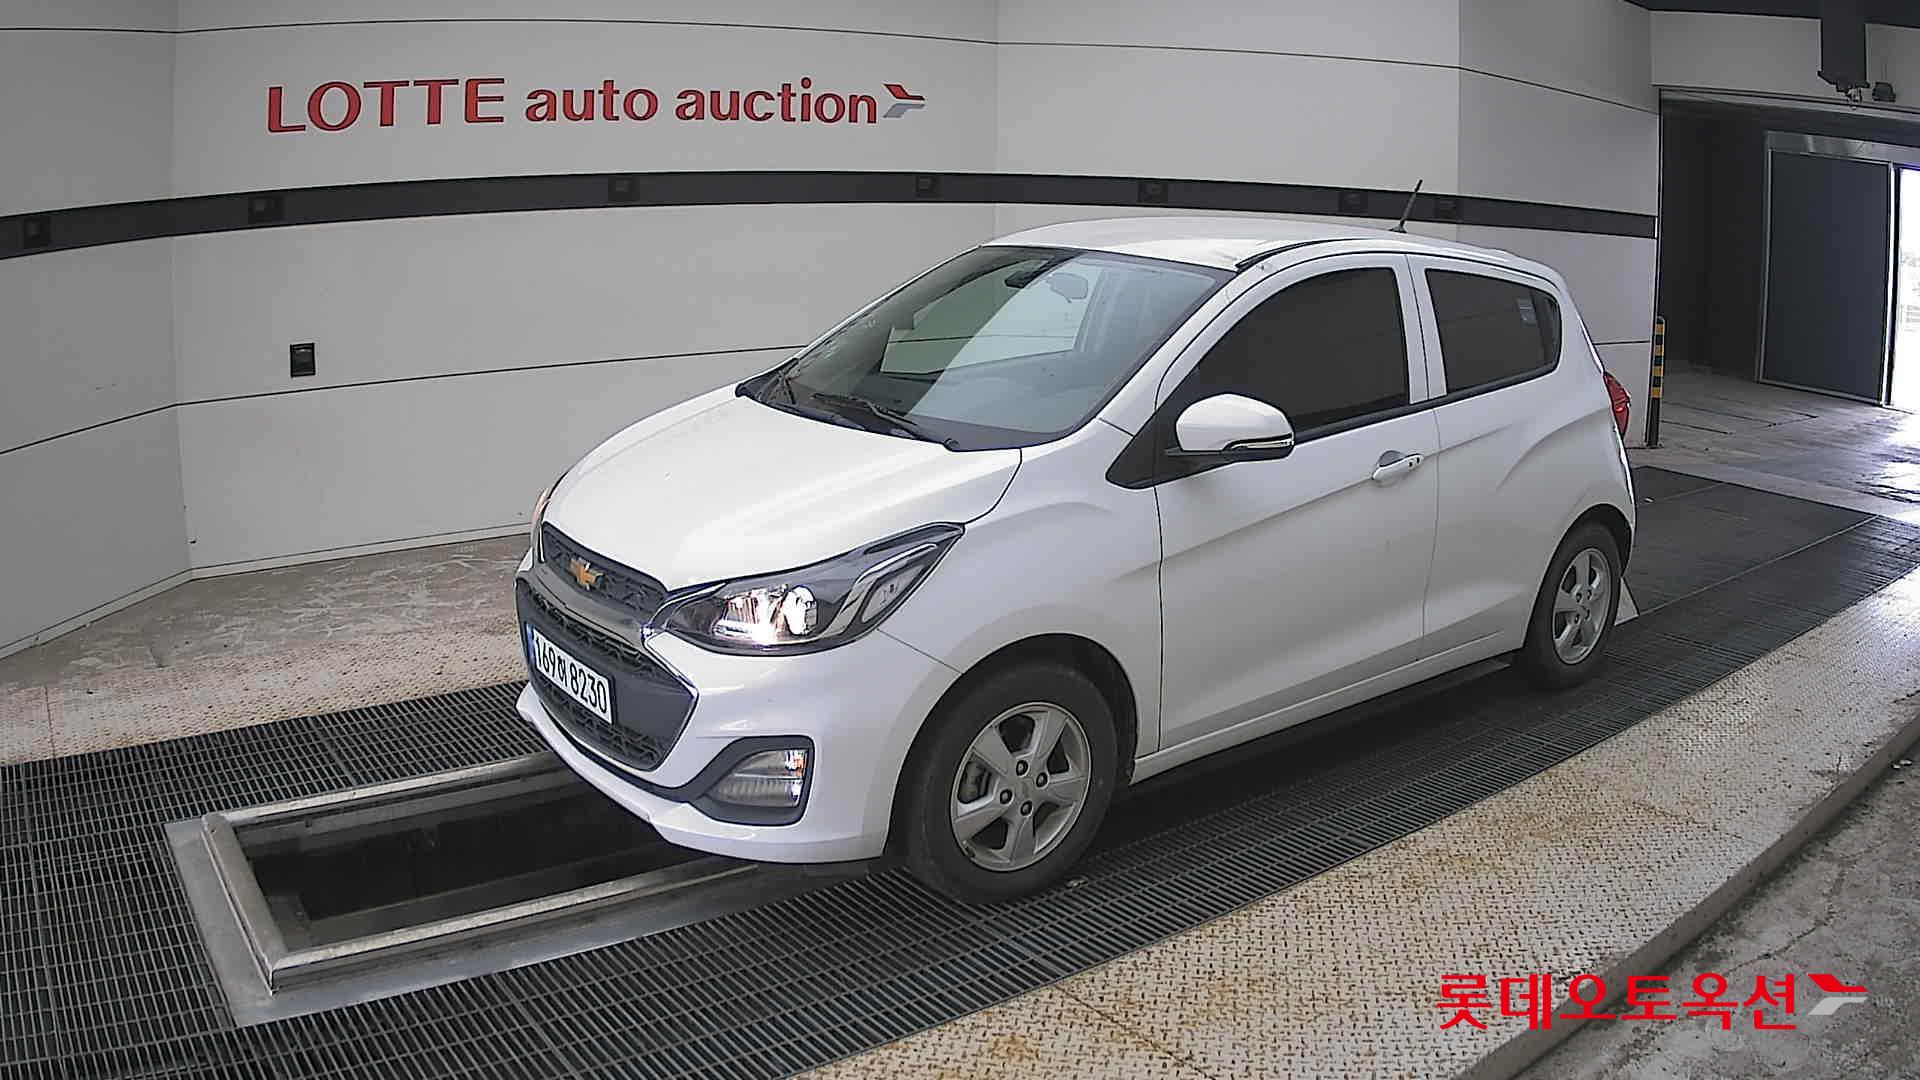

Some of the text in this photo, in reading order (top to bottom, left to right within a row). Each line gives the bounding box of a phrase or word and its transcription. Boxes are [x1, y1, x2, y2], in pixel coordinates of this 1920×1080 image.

[267, 77, 878, 133] LOTTE auto auction
